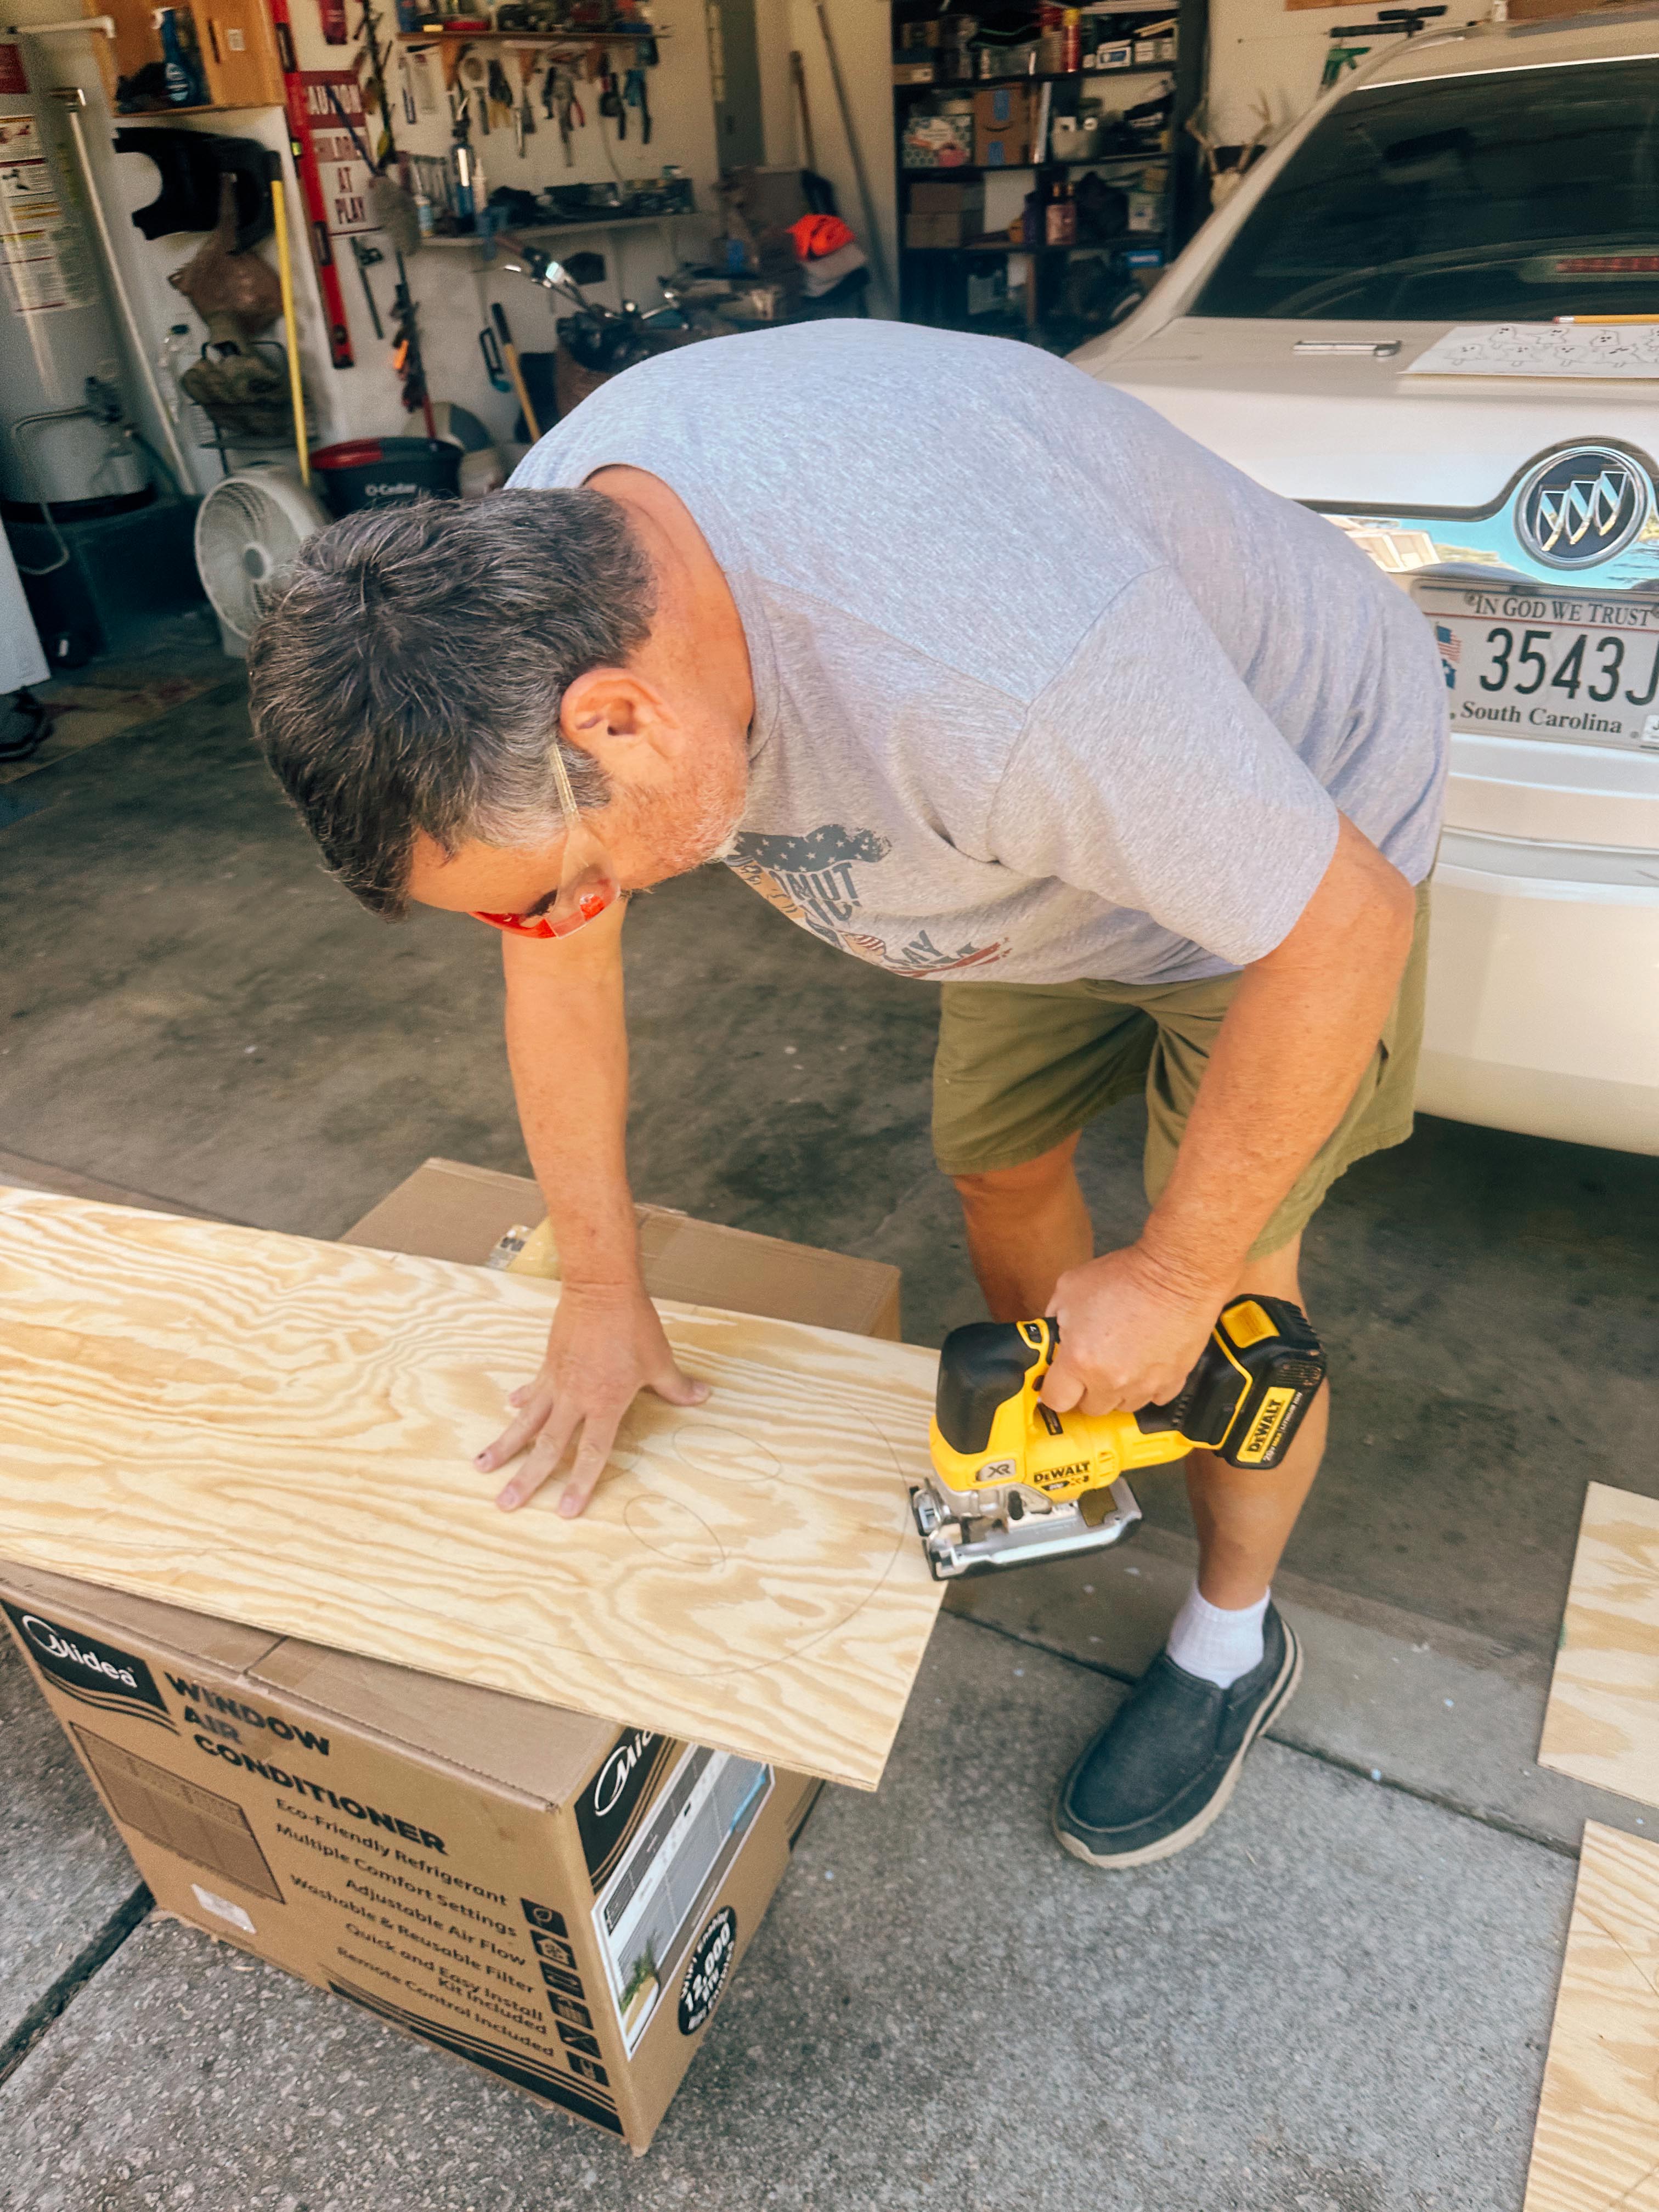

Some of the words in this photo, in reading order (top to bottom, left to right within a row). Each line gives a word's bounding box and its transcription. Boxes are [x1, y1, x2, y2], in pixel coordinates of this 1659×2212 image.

[335, 196, 365, 224] PLAY
[337, 166, 353, 193] AT
[1474, 594, 1496, 615] IN
[1502, 597, 1546, 619] GOD
[1552, 600, 1582, 622] WE
[1589, 603, 1652, 626] TRUST
[1460, 701, 1521, 724] South
[1528, 707, 1623, 734] Carolina
[988, 1463, 1011, 1478] XR
[22, 1615, 137, 1689] Midea
[163, 1671, 330, 1756] WINDOW
[184, 1705, 244, 1745] AIR
[194, 1734, 448, 1856] CONDITIONER
[276, 1798, 390, 1855] Eco-Friendly
[394, 1849, 508, 1906] Refrigerant
[276, 1822, 350, 1863] Multiple
[354, 1858, 432, 1900] Comfort
[437, 1894, 517, 1937] Settings
[290, 1874, 376, 1922] Washable
[380, 1916, 393, 1930] &
[398, 1924, 482, 1970] Reusable
[486, 1965, 535, 1994] Filter
[346, 1879, 444, 1931] Adjustable
[448, 1925, 475, 1944] Air
[480, 1938, 526, 1966] Flow
[337, 1946, 402, 1984] Remote
[405, 1979, 471, 2018] Control
[475, 2012, 554, 2057] Included
[345, 1922, 396, 1954] Quick
[400, 1950, 435, 1972] and
[439, 1966, 481, 1993] Easy
[484, 1987, 543, 2021] Install
[438, 1977, 462, 1996] Kit
[466, 1990, 548, 2035] Included
